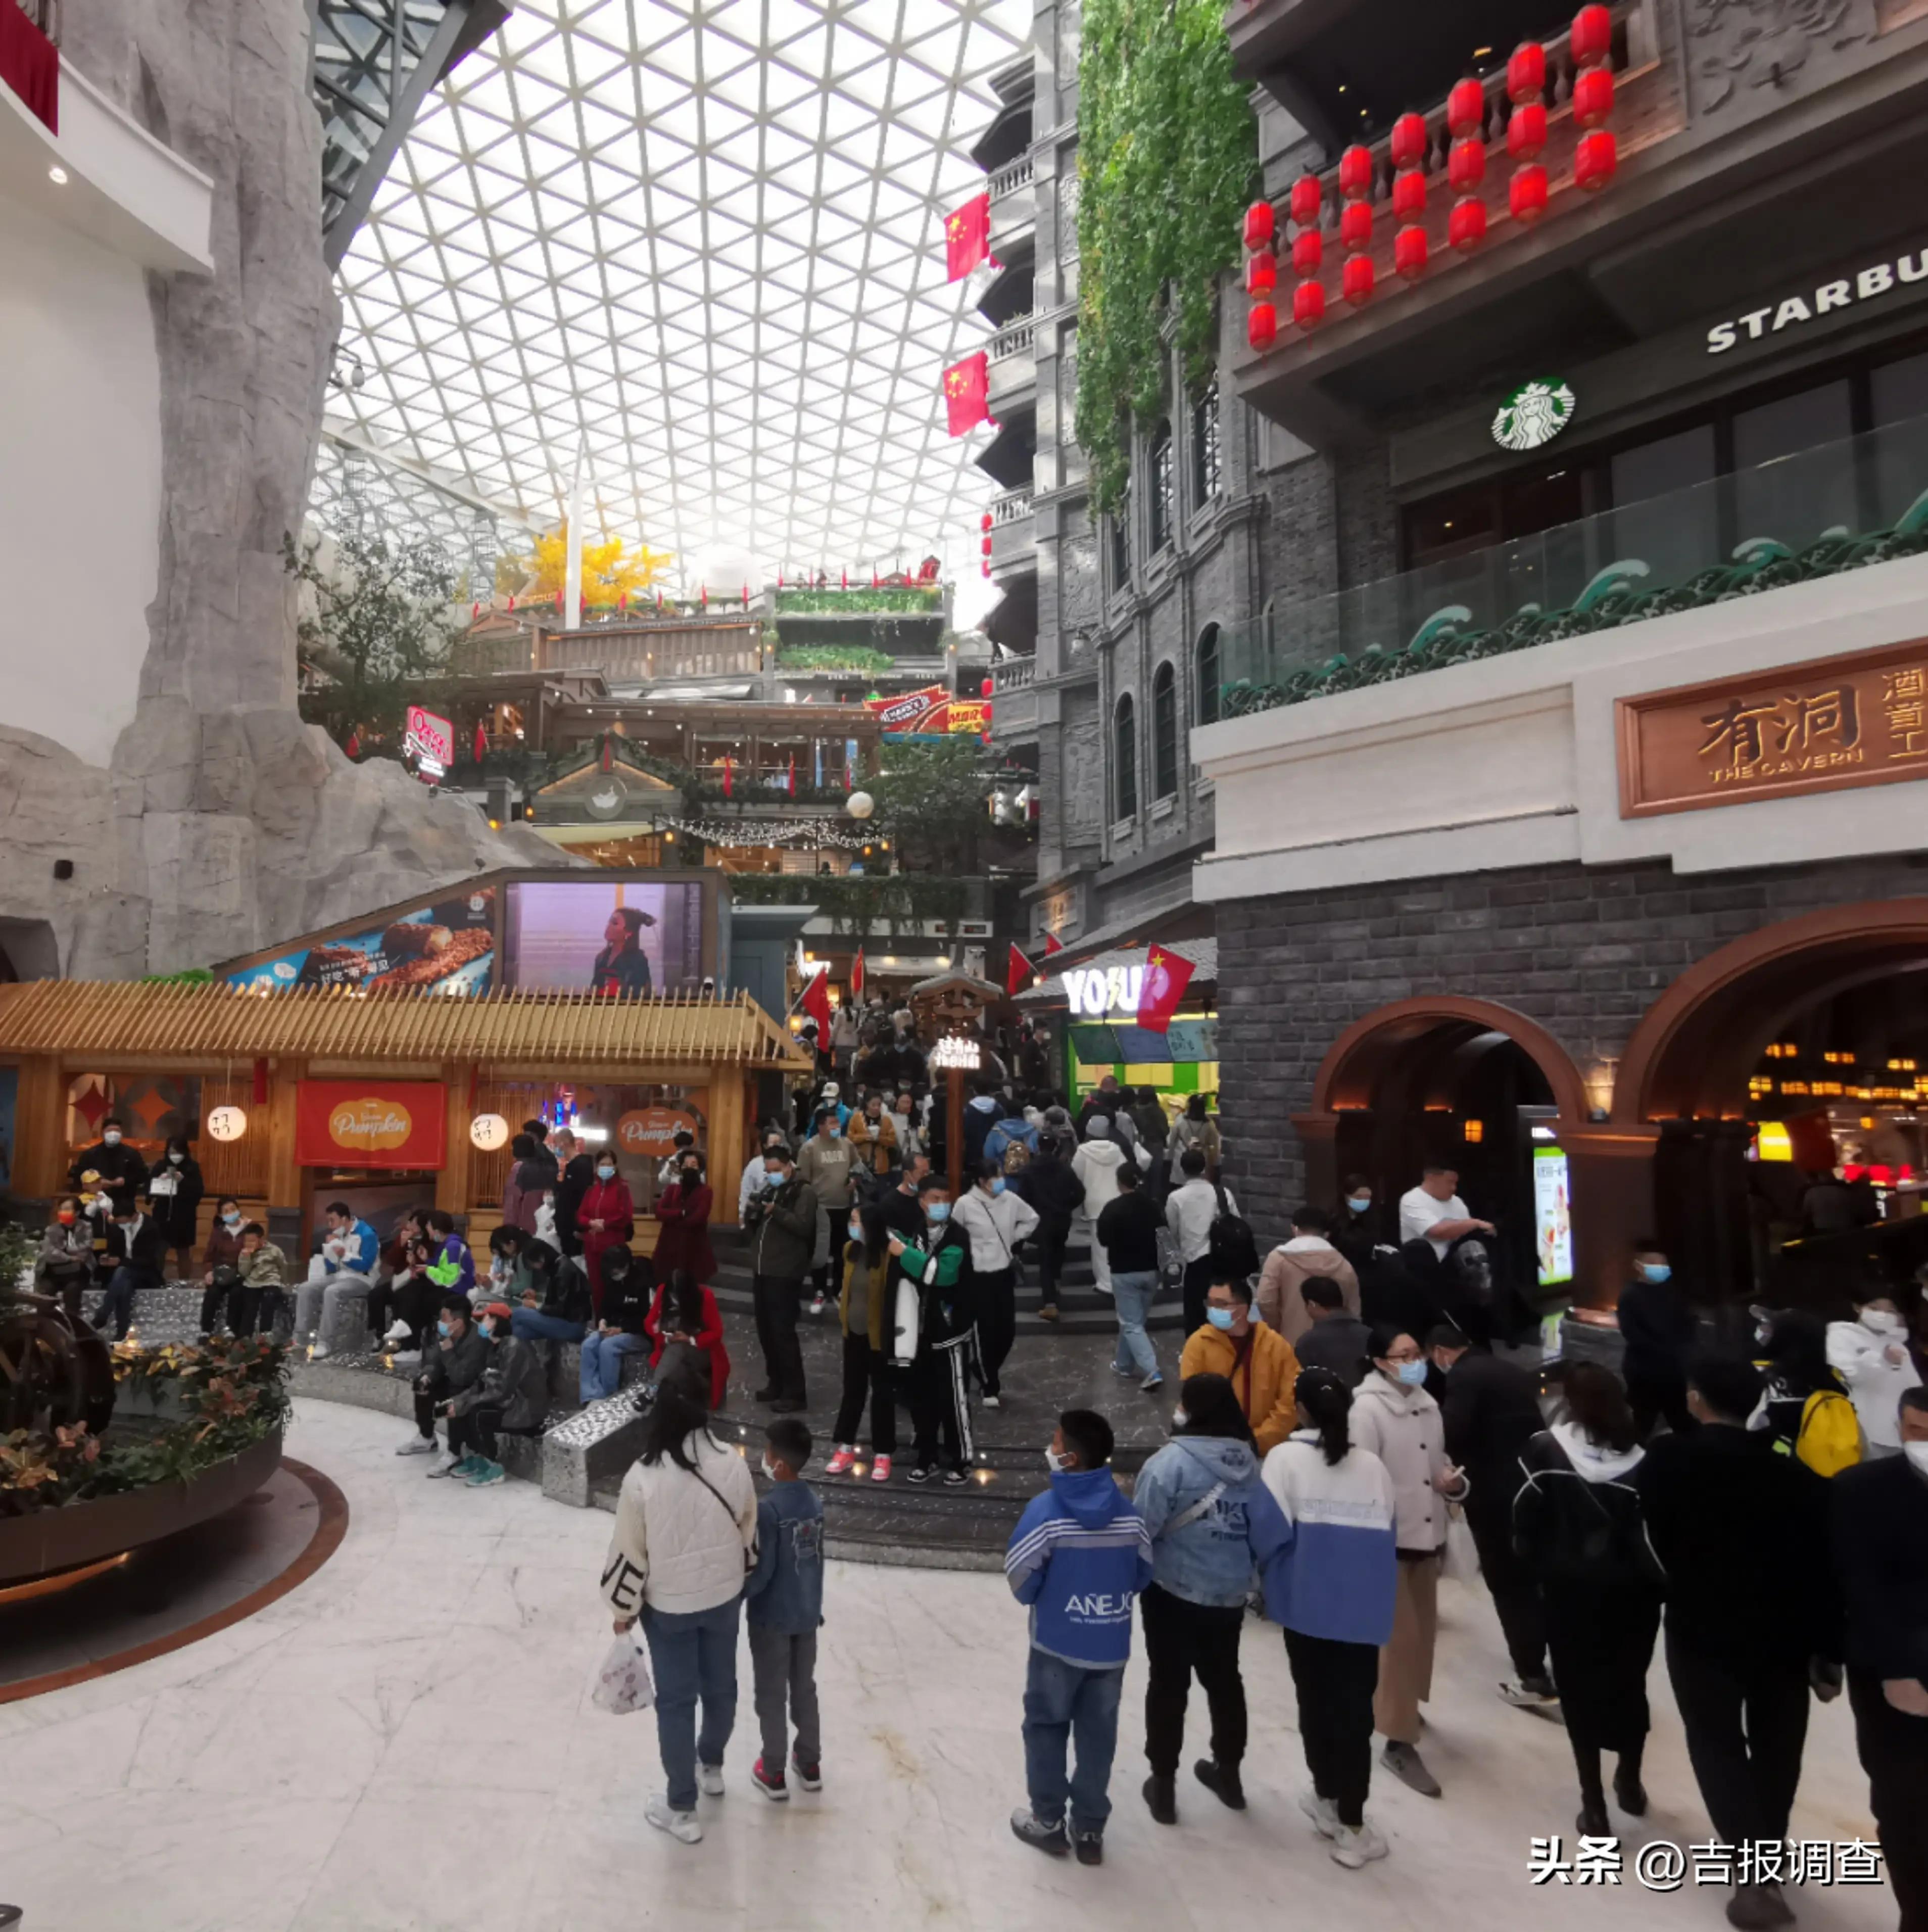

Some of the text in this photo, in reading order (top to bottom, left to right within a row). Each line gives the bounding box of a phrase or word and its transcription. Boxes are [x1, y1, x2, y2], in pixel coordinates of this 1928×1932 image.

[1698, 684, 1862, 768] 有洞
[1709, 748, 1864, 784] THE CAVERN
[333, 1112, 406, 1138] Pumpkin
